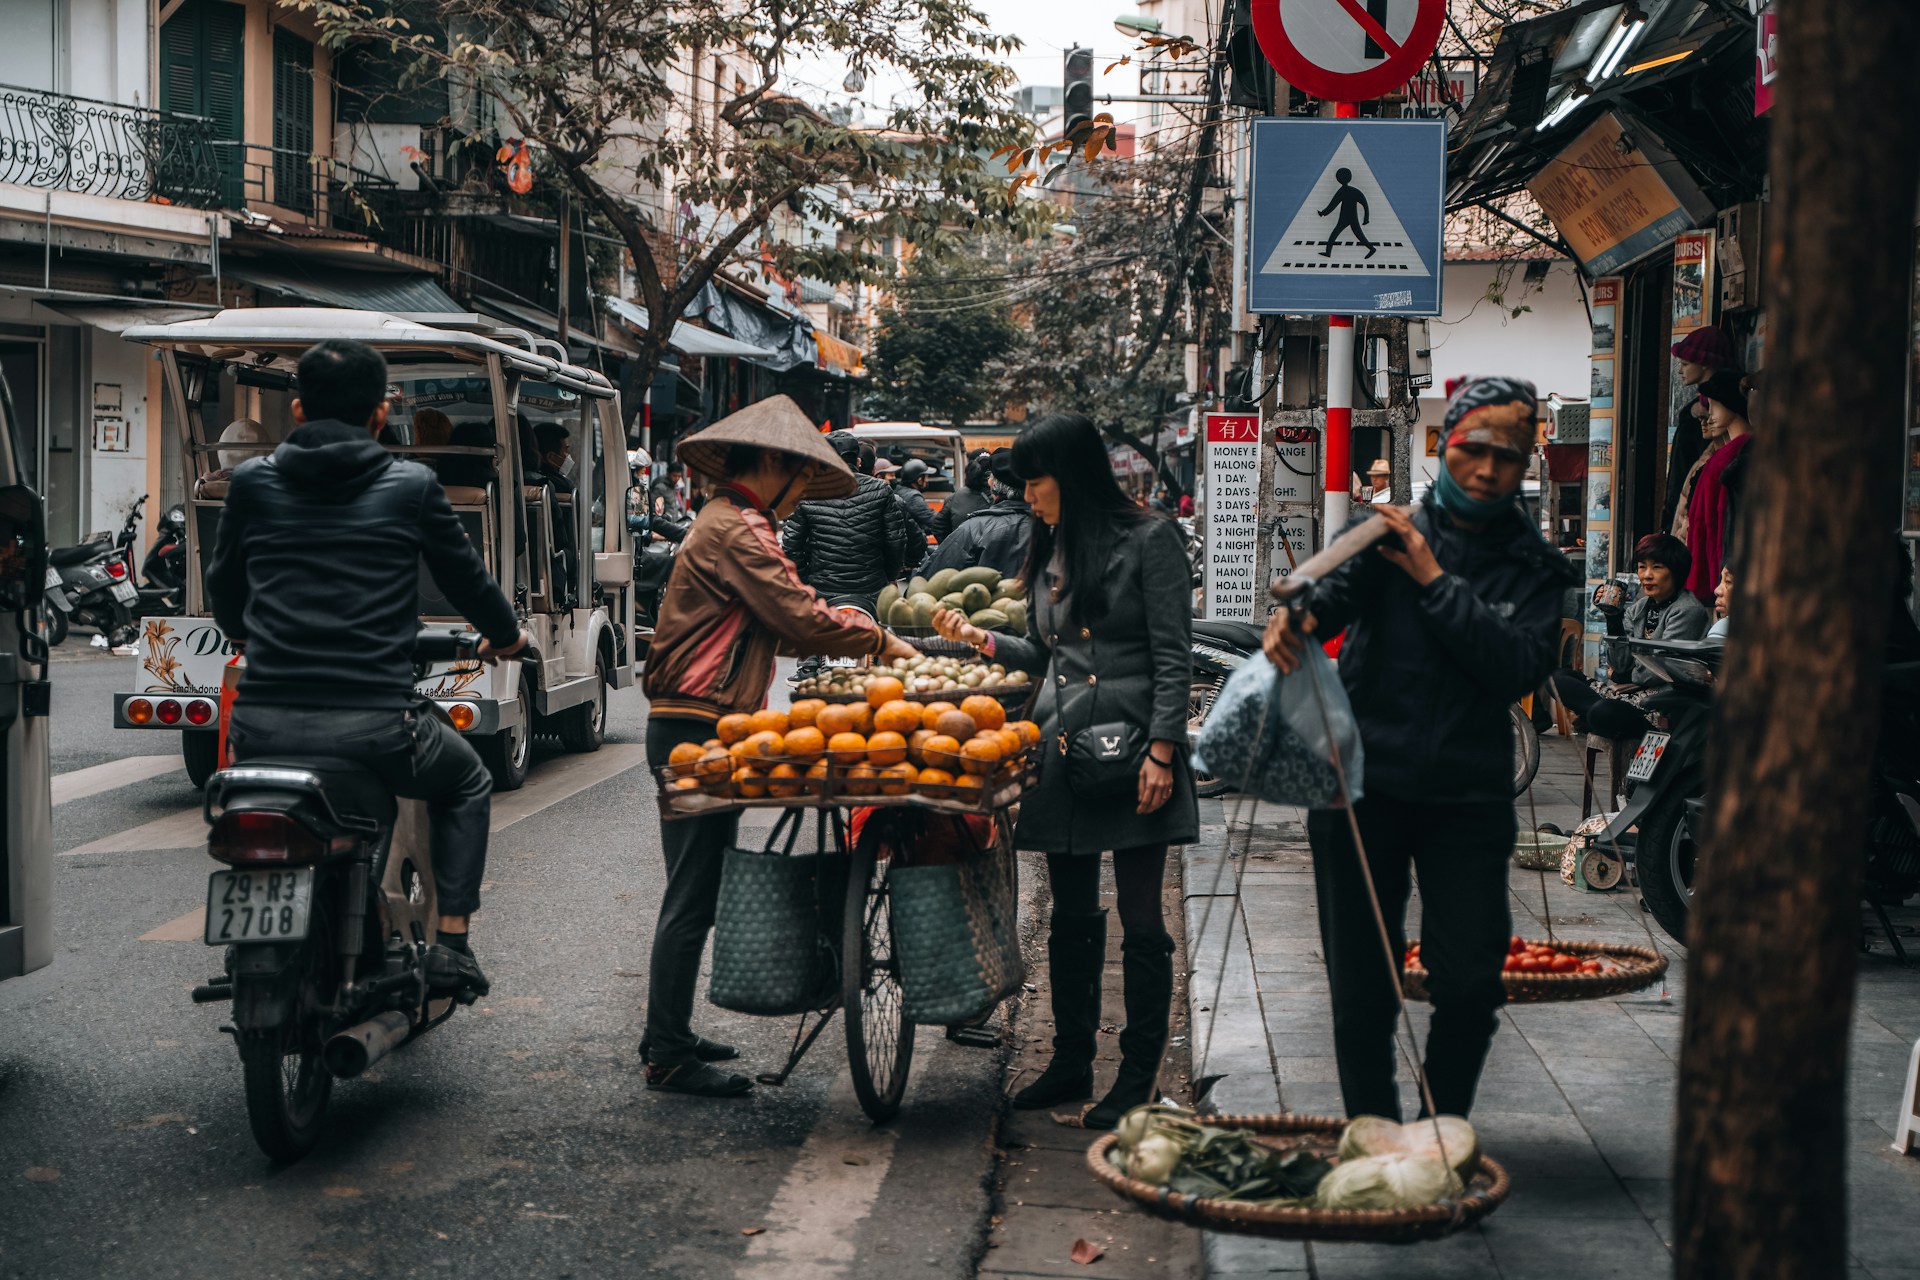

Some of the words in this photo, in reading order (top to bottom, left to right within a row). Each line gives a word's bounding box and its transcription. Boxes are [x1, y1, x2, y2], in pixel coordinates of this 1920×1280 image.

[1577, 204, 1624, 247] BOOKING
[1607, 187, 1650, 228] OFFICE
[1213, 447, 1248, 457] MONEY
[1252, 447, 1306, 457] EANGE
[1213, 460, 1256, 470] HALONG
[1217, 474, 1221, 483] 1
[1225, 474, 1247, 483] DAY:
[1216, 487, 1223, 496] 2
[1225, 487, 1250, 496] DAYS
[1216, 501, 1222, 510] 3
[1225, 501, 1250, 510] DAYS
[1213, 514, 1239, 523] SAPA
[1216, 528, 1222, 537] 3
[1225, 528, 1255, 537] NIGHT
[1216, 541, 1223, 550] 4
[1225, 541, 1255, 550] NIGHT
[1278, 541, 1305, 550] DYS:
[1213, 555, 1240, 564] DAILY
[1216, 568, 1249, 577] HANOI
[1216, 581, 1238, 590] HOA
[1216, 595, 1232, 604] BAI
[1235, 595, 1252, 604] DIN
[1216, 608, 1252, 617] PERFUM
[222, 871, 297, 905] 29-R3
[219, 905, 293, 939] 2708
